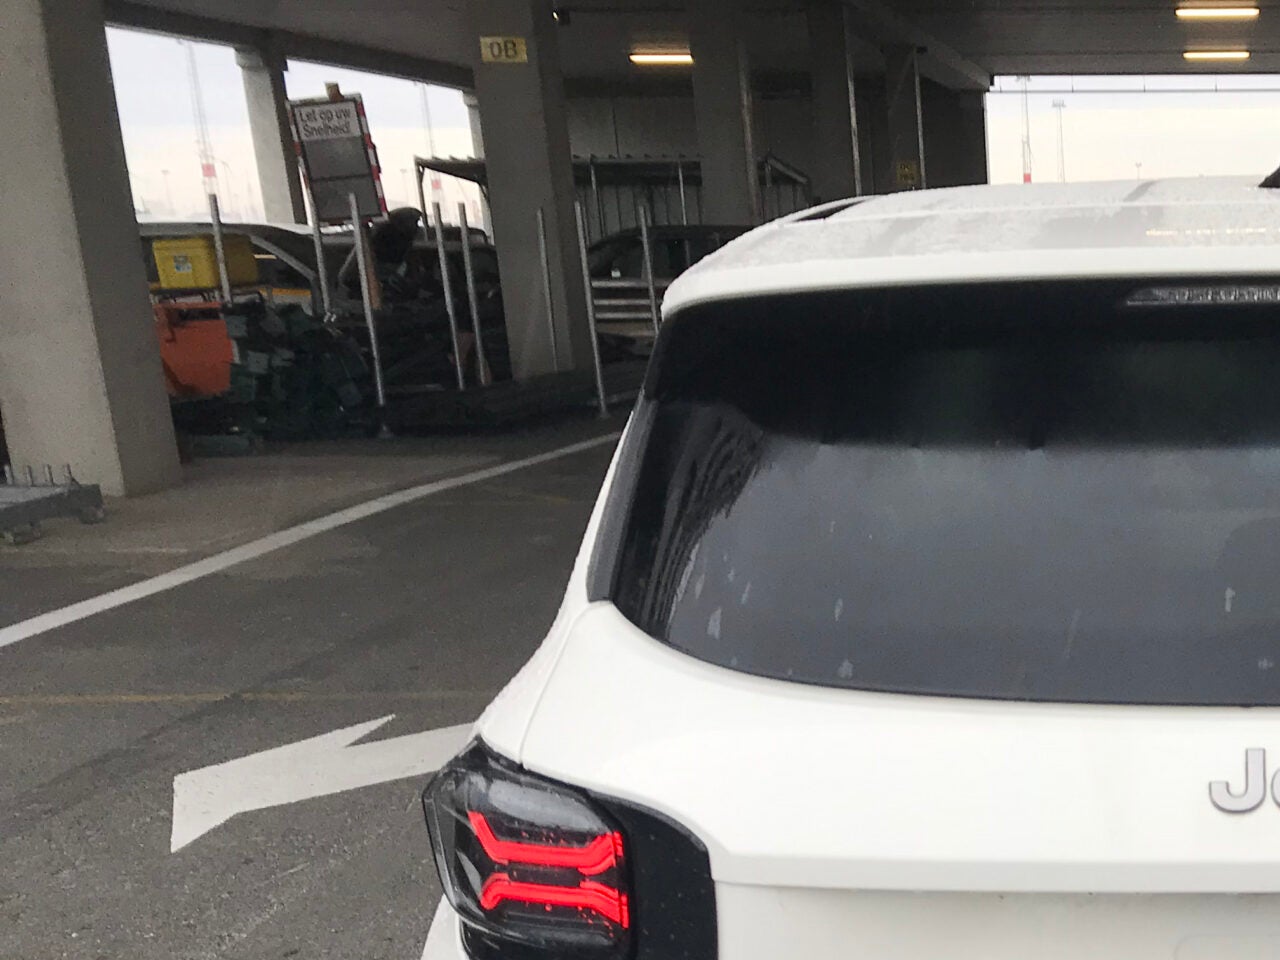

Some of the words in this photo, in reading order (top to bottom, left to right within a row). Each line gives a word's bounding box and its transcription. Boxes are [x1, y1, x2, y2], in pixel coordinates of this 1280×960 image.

[299, 109, 318, 121] Let
[319, 109, 334, 124] op
[335, 107, 351, 119] uw
